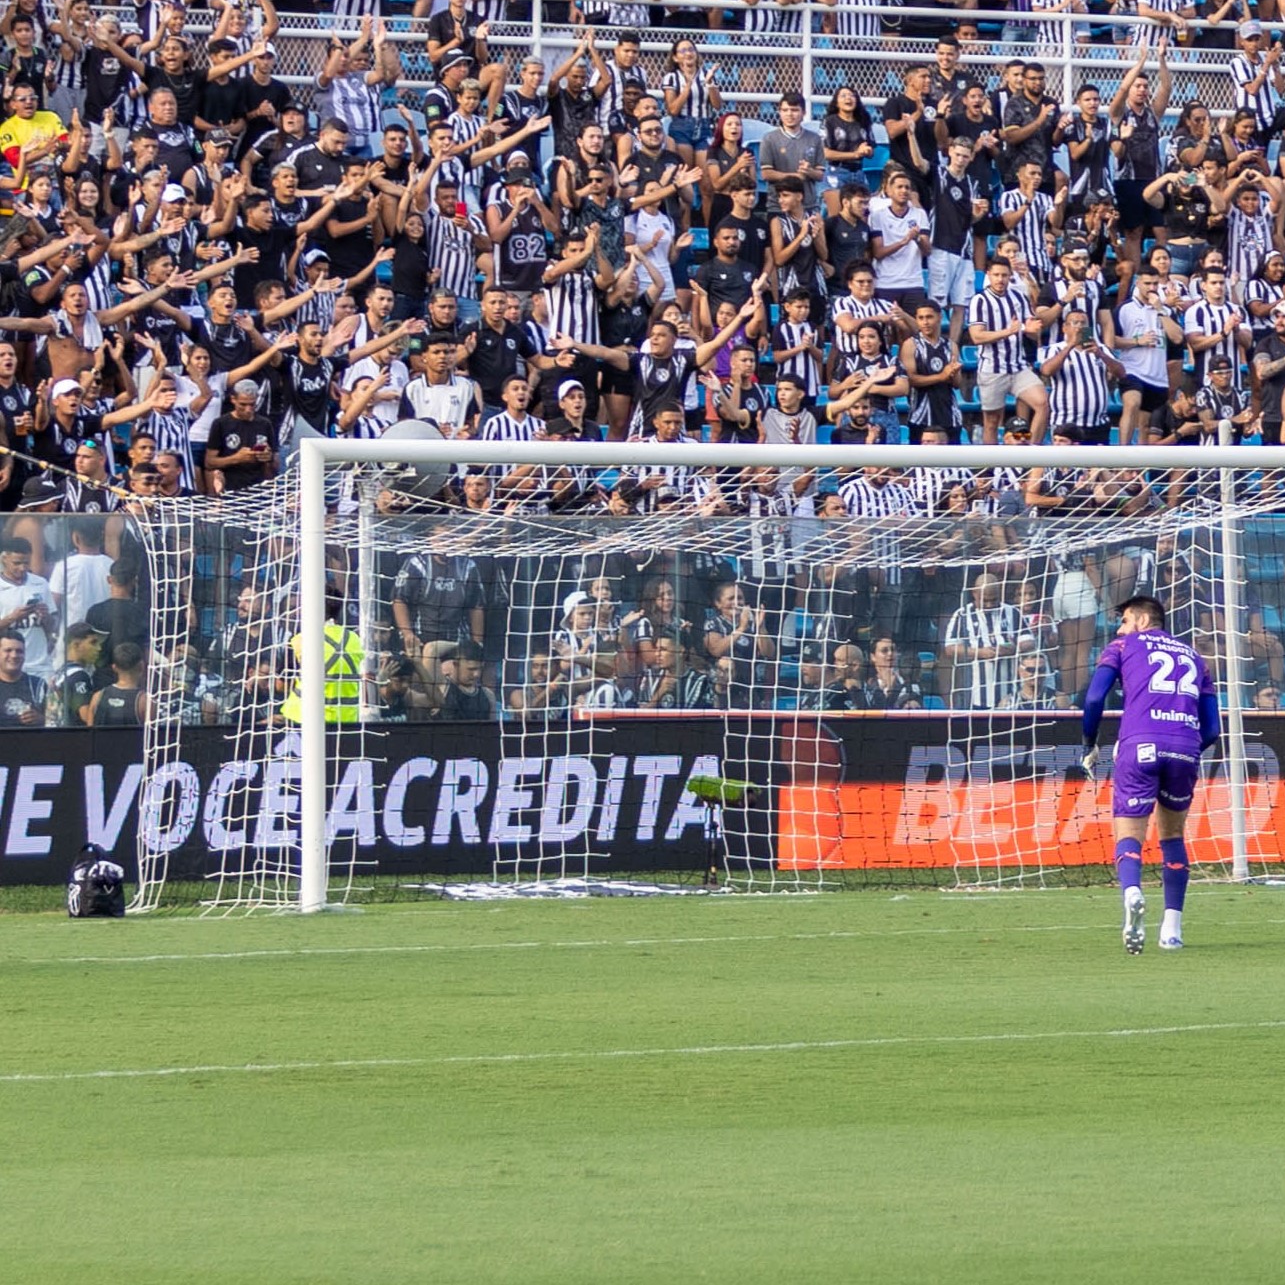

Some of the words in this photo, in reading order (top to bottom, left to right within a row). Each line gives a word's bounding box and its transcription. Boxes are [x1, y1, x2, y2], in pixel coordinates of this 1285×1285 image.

[509, 233, 547, 264] 82
[1148, 651, 1200, 698] 22
[84, 729, 306, 854] VOCÊ
[325, 755, 723, 847] ACREDITA
